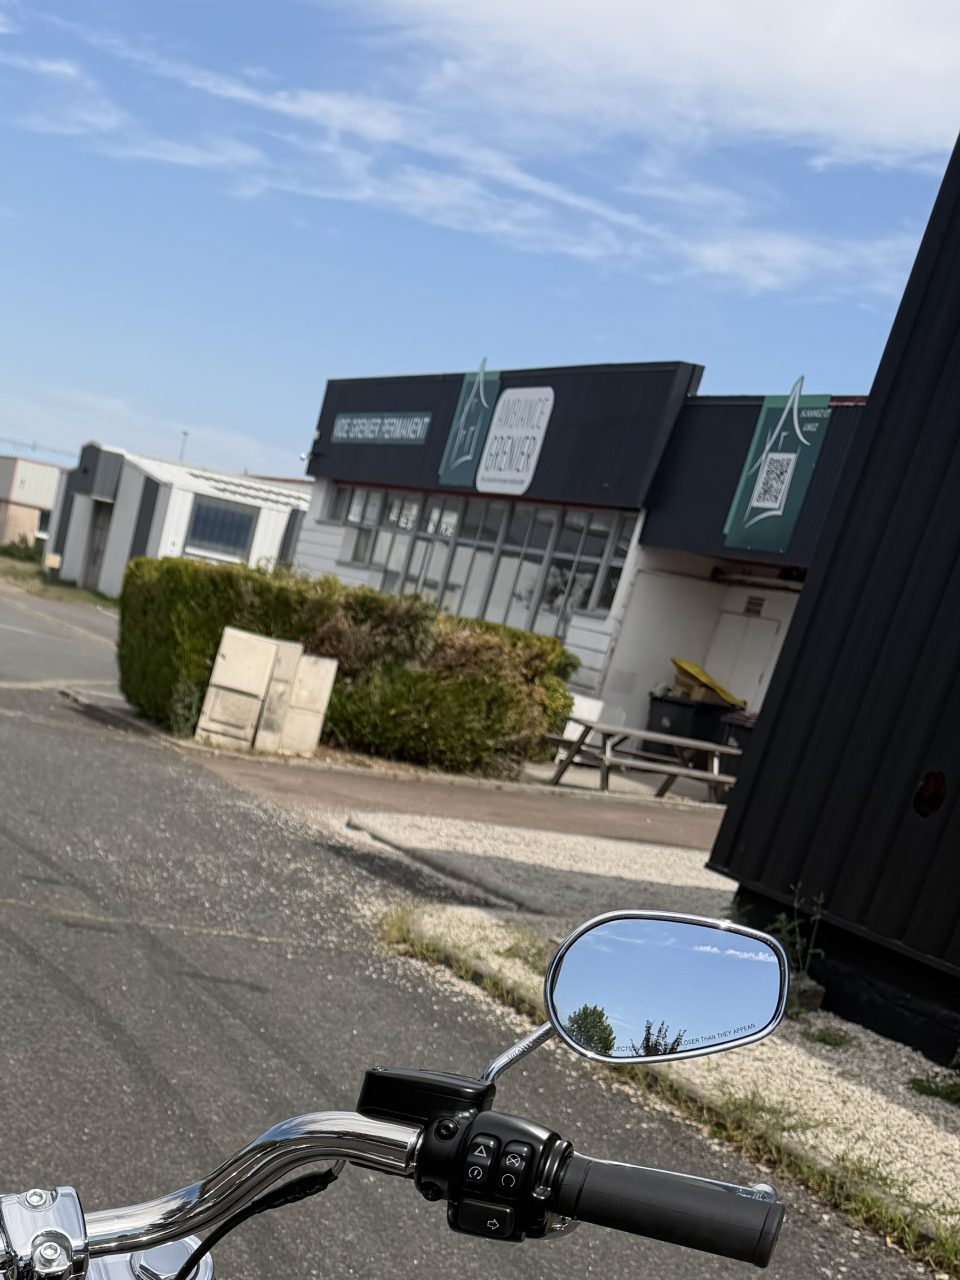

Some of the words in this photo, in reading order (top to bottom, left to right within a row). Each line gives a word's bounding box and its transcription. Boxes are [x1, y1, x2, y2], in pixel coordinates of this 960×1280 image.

[700, 1034, 717, 1043] THAN
[717, 1030, 732, 1040] THEY
[733, 1023, 756, 1035] APPEAR
